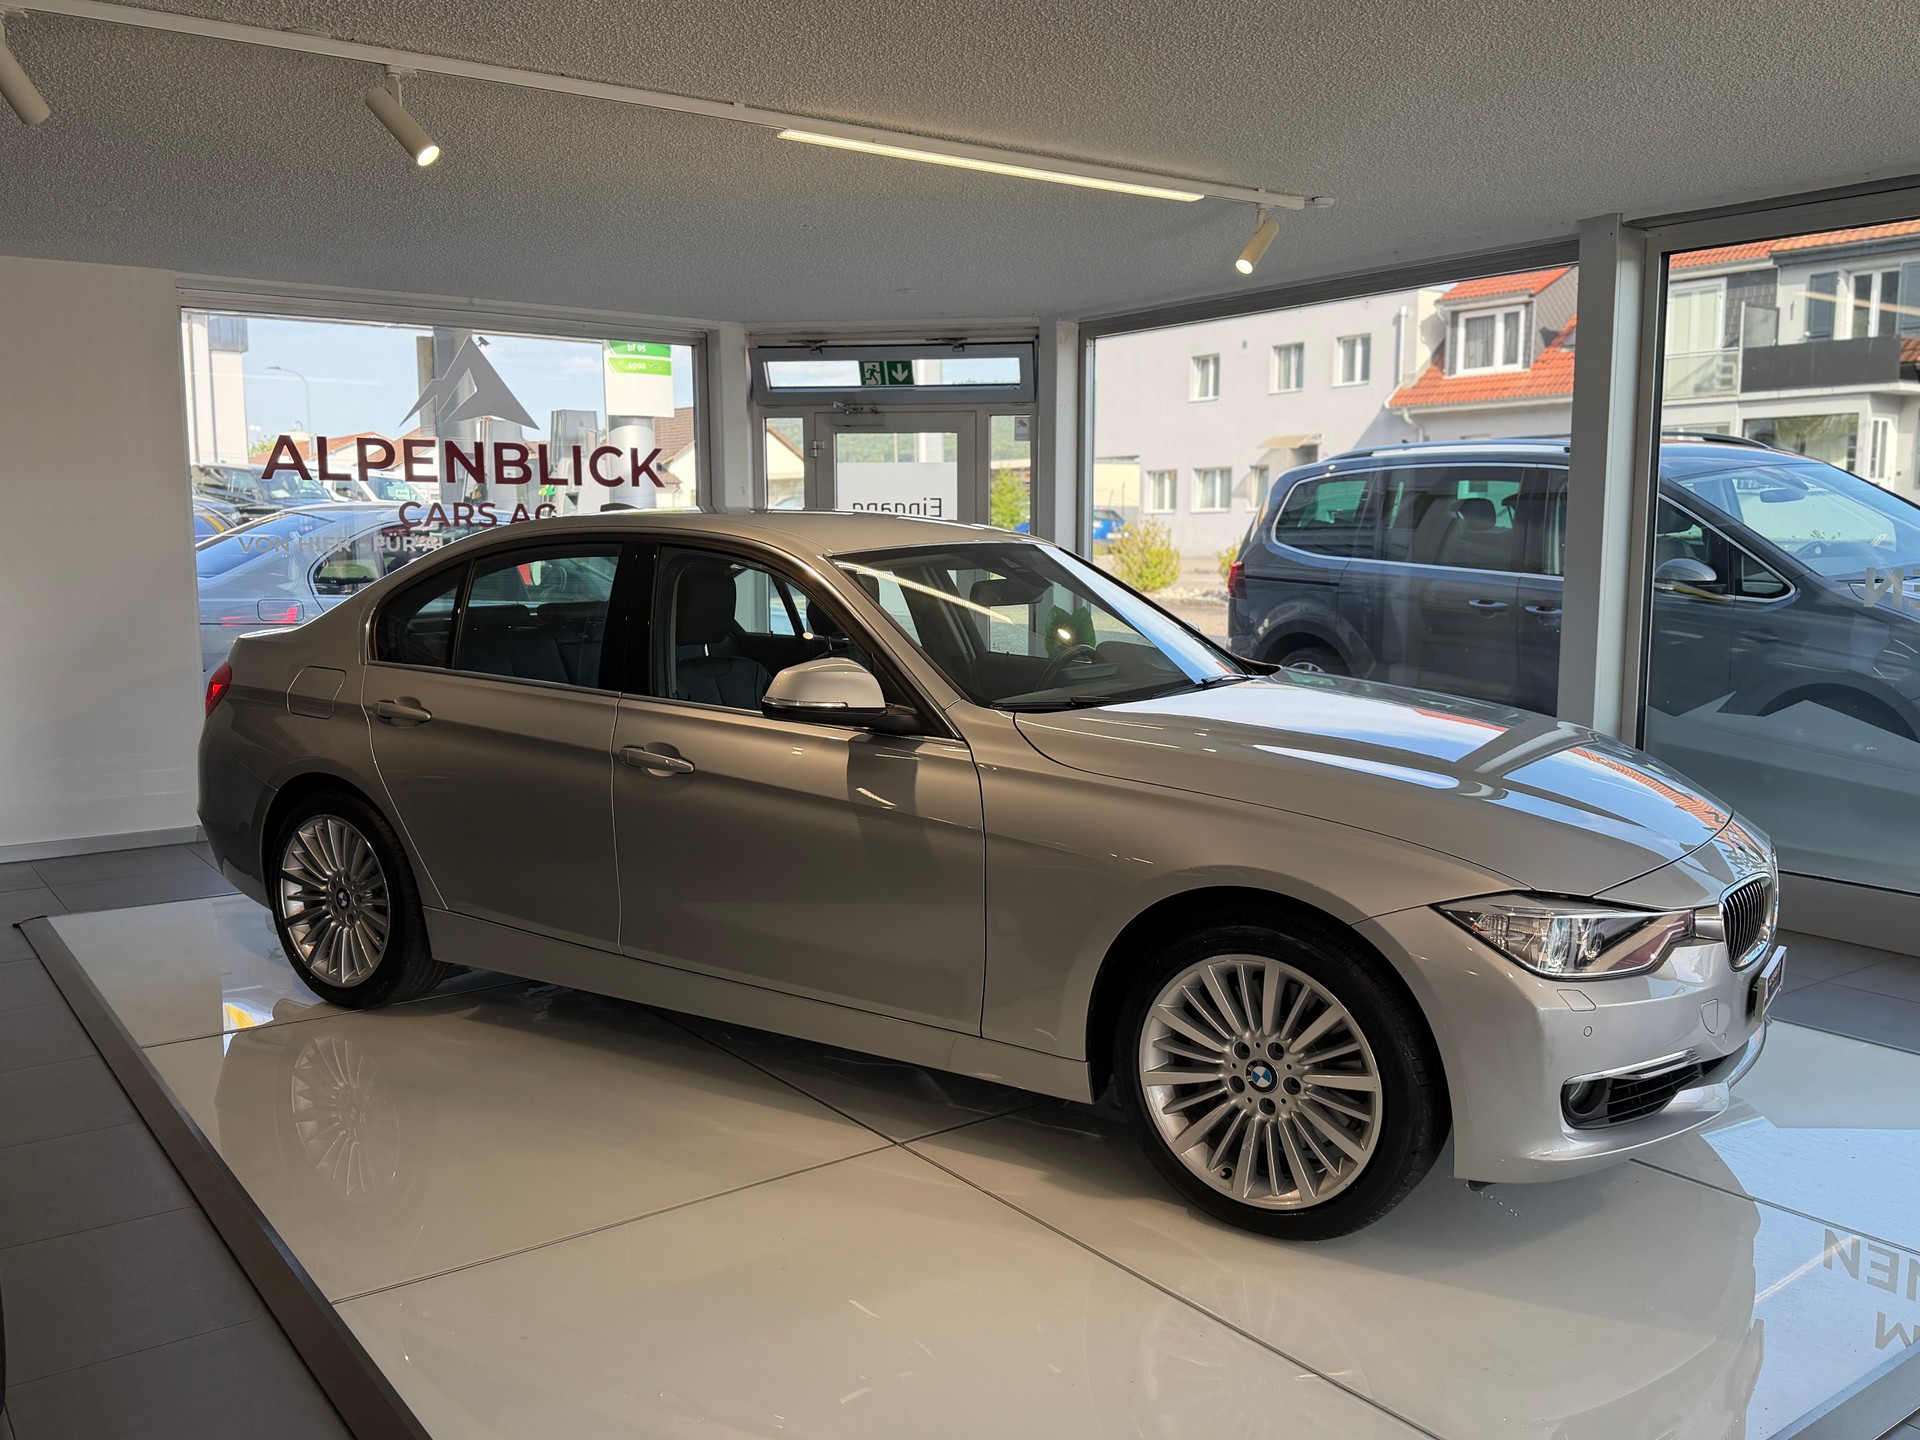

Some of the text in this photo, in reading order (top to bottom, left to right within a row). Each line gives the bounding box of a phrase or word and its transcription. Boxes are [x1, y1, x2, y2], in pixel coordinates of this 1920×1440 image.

[261, 435, 665, 488] ALPENBLICK
[399, 501, 498, 528] CARS
[237, 536, 290, 553] VON
[299, 536, 352, 553] HIER
